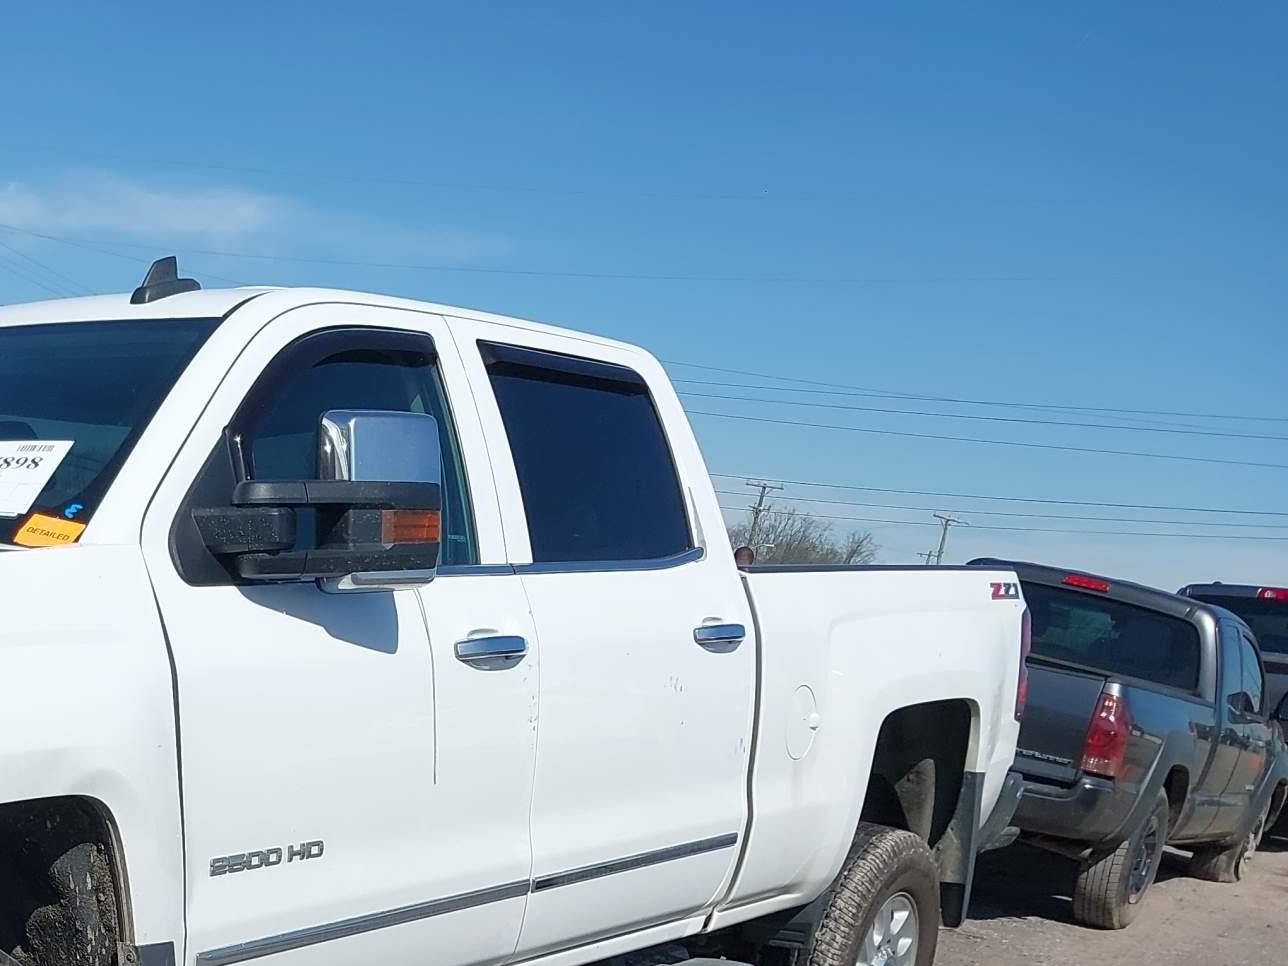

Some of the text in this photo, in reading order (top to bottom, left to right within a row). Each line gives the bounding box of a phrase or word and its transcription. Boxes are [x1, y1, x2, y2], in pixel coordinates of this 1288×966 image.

[26, 526, 71, 542] DETAILED
[989, 582, 1021, 600] Z71
[209, 840, 325, 877] 2500 HD
